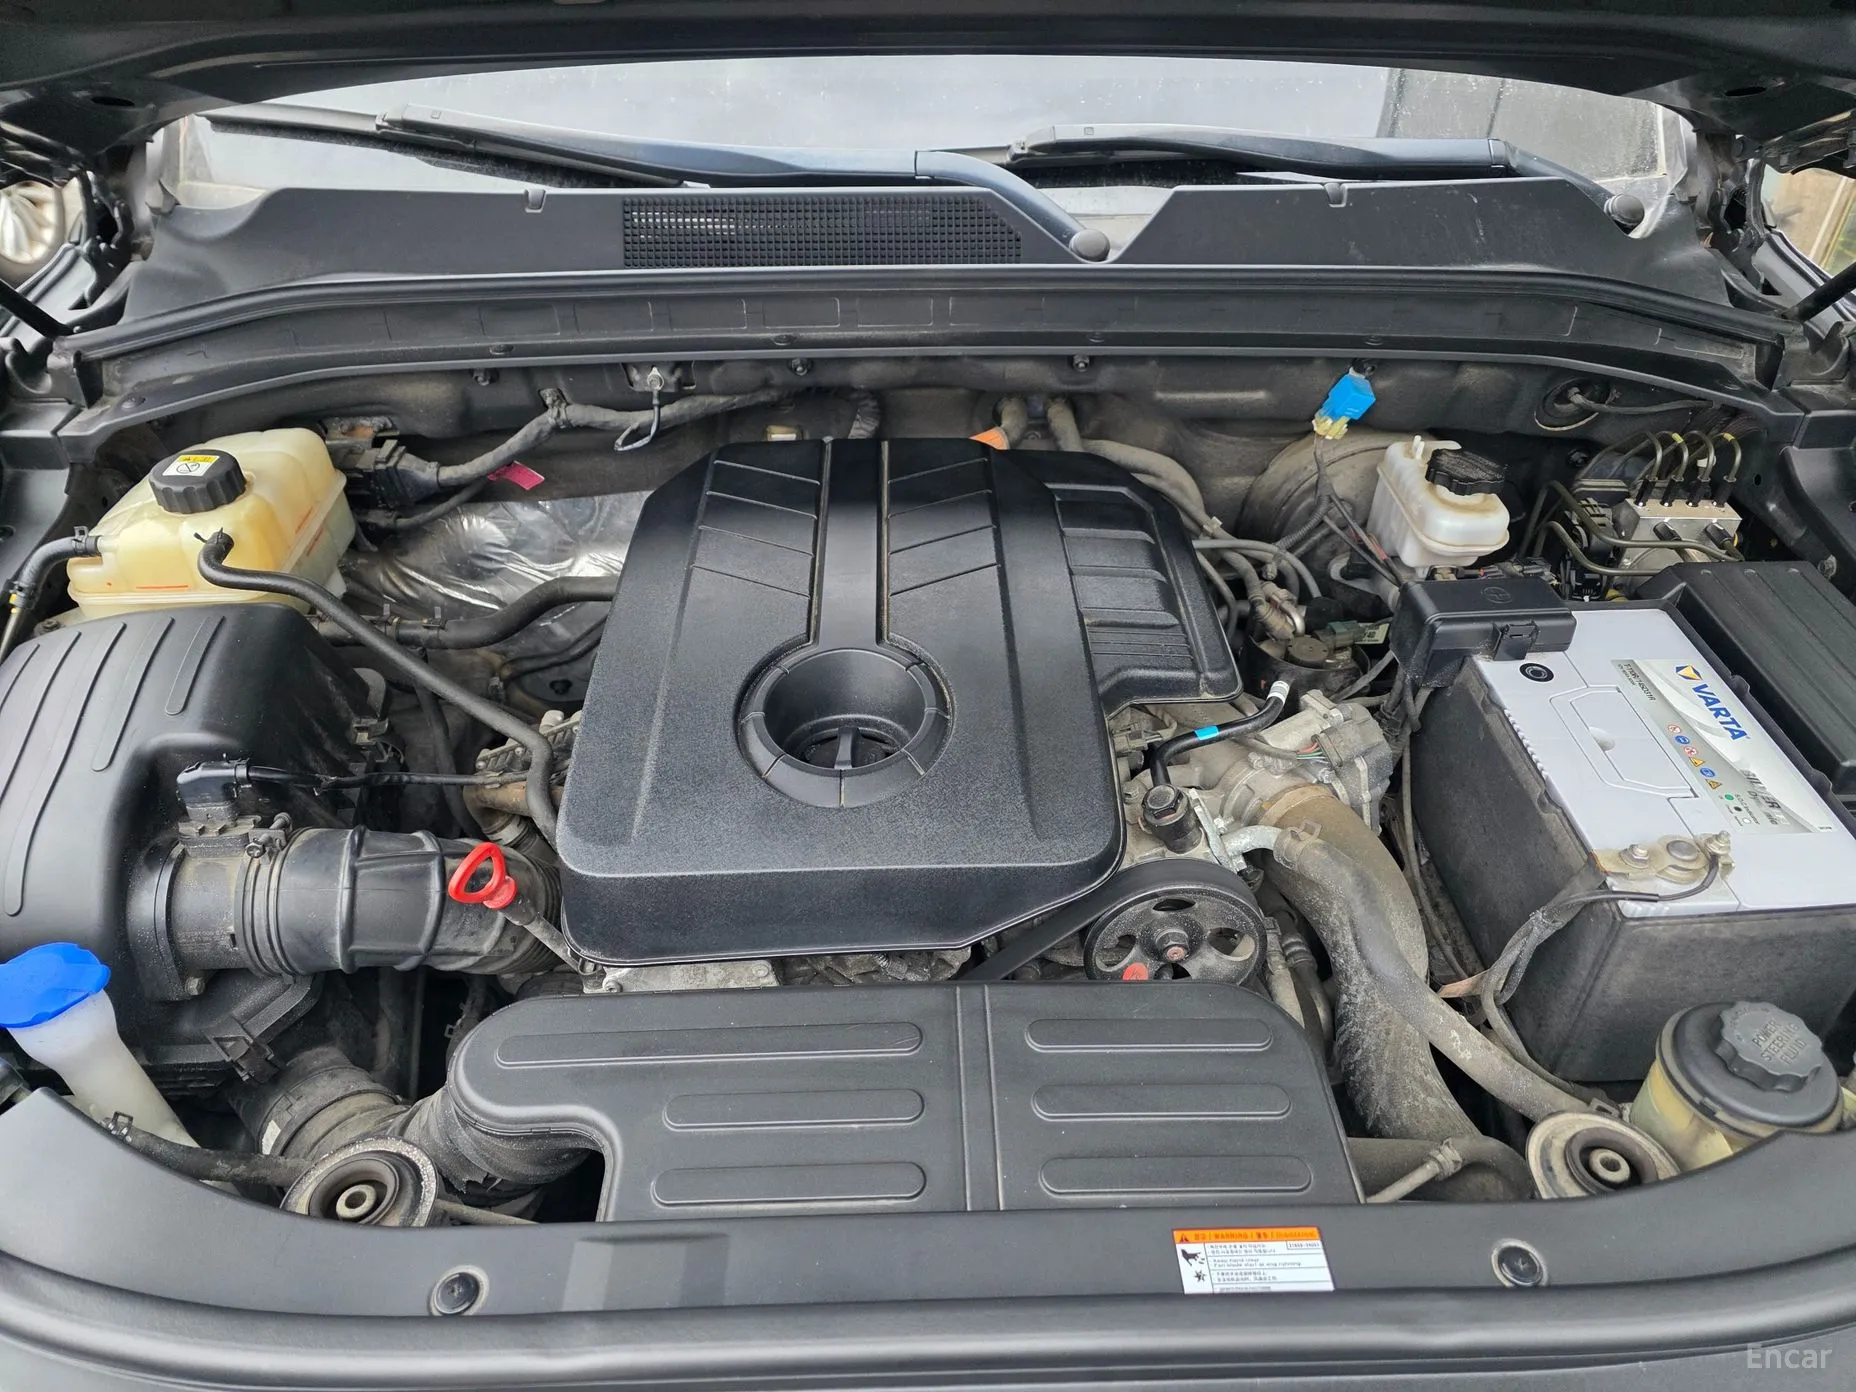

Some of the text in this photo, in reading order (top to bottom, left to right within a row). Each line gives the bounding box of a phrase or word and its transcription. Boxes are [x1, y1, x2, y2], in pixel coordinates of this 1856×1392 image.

[1692, 683, 1747, 740] VARTA
[1752, 1019, 1779, 1048] POWER
[1761, 1022, 1800, 1062] STEERING
[1780, 1038, 1807, 1065] FLUID
[1214, 1232, 1248, 1240] WARNING
